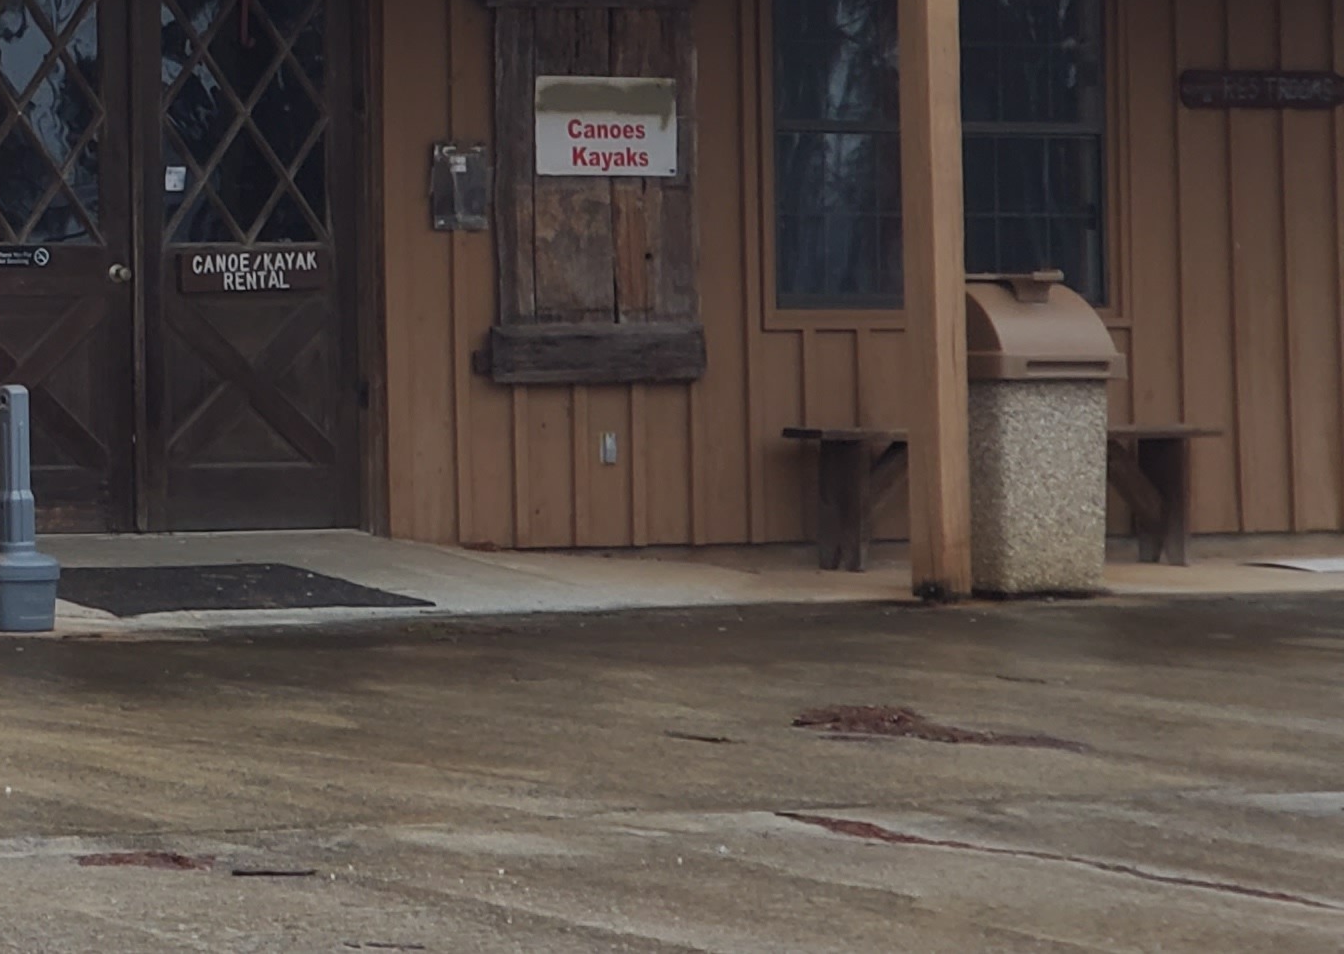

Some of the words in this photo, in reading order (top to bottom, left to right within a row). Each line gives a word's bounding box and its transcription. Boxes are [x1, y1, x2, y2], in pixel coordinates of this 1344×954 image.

[567, 119, 646, 139] Canoes
[572, 146, 649, 172] Kayaks
[223, 271, 291, 291] RENTAL
